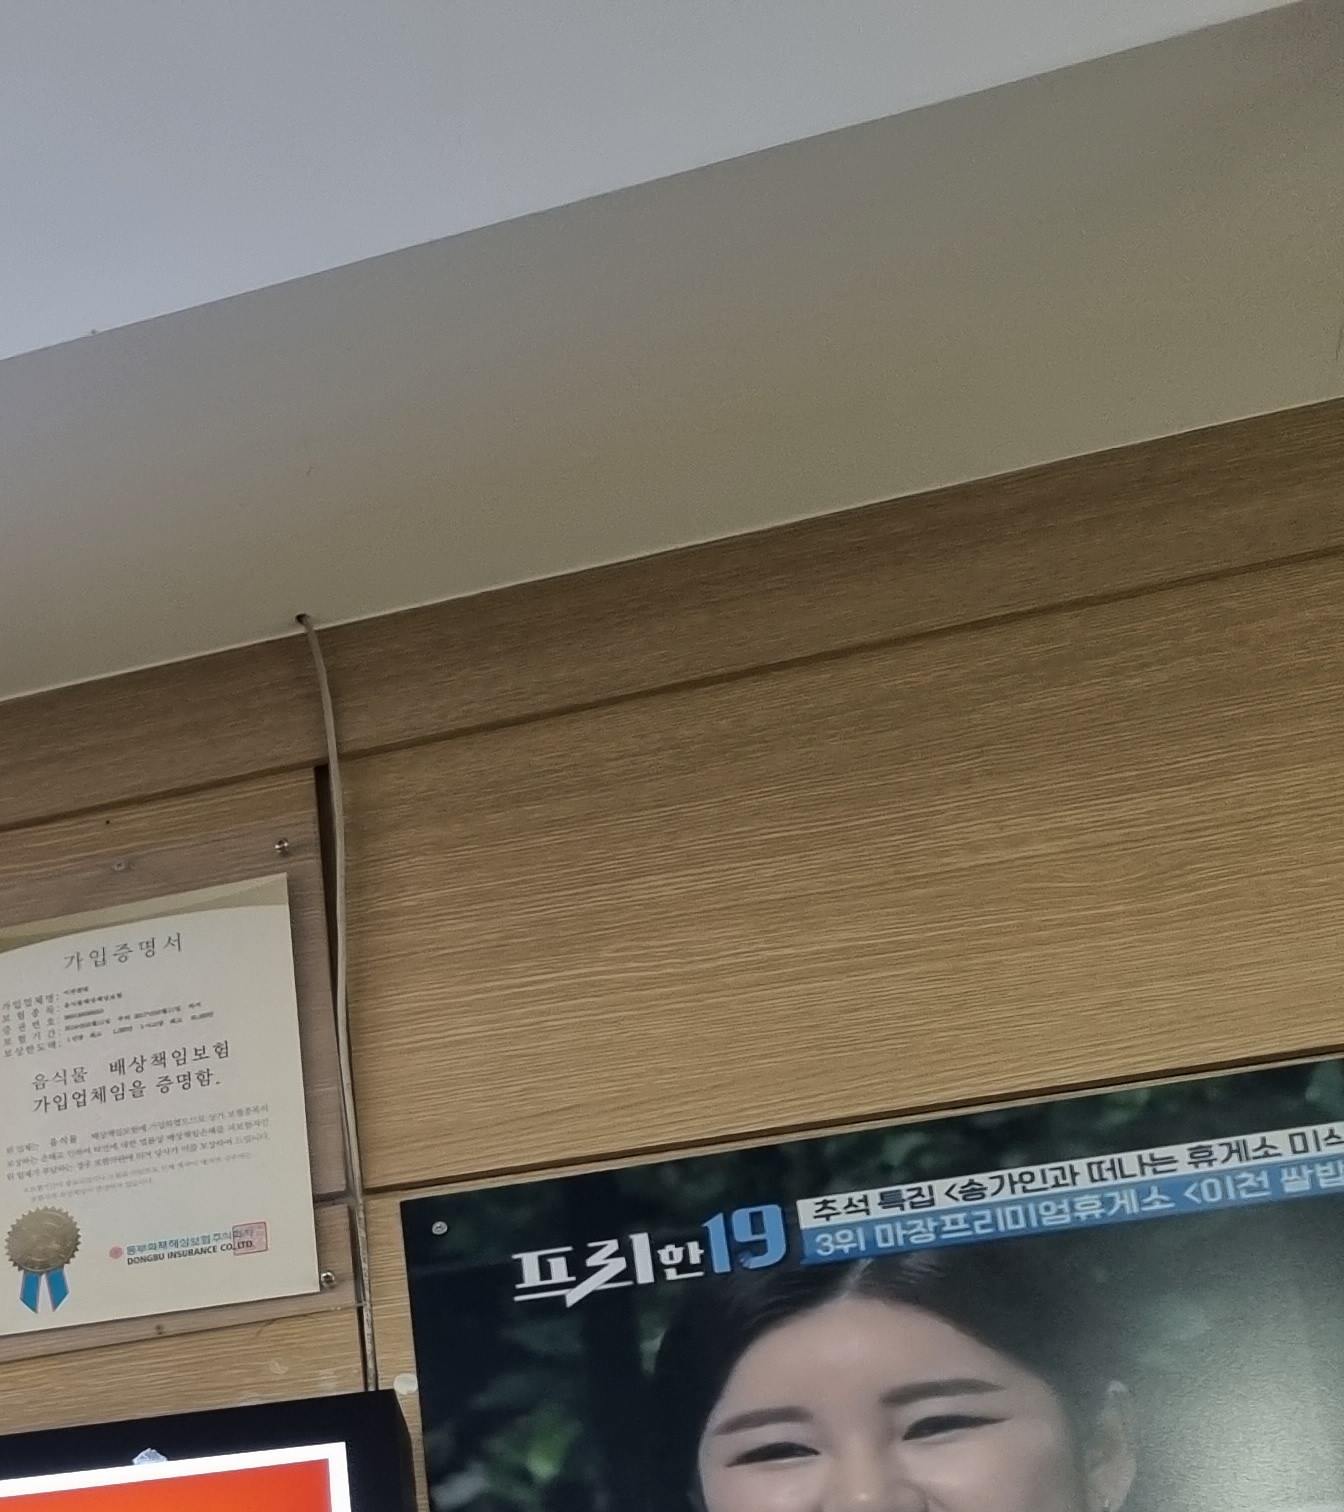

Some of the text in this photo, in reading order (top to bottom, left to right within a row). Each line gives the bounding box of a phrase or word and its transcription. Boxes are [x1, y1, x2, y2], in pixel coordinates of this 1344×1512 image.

[64, 932, 183, 972] 가입증명서
[32, 1040, 230, 1091] 음식물 배상책임보험
[32, 1079, 146, 1114] 가입업체임을
[812, 1197, 872, 1223] 추석
[877, 1184, 936, 1211] 특집
[1087, 1152, 1179, 1183] 떠나는
[1186, 1135, 1283, 1169] 휴게소
[815, 1229, 865, 1257] 3위
[875, 1184, 1177, 1249] 마장프리미엄휴게소
